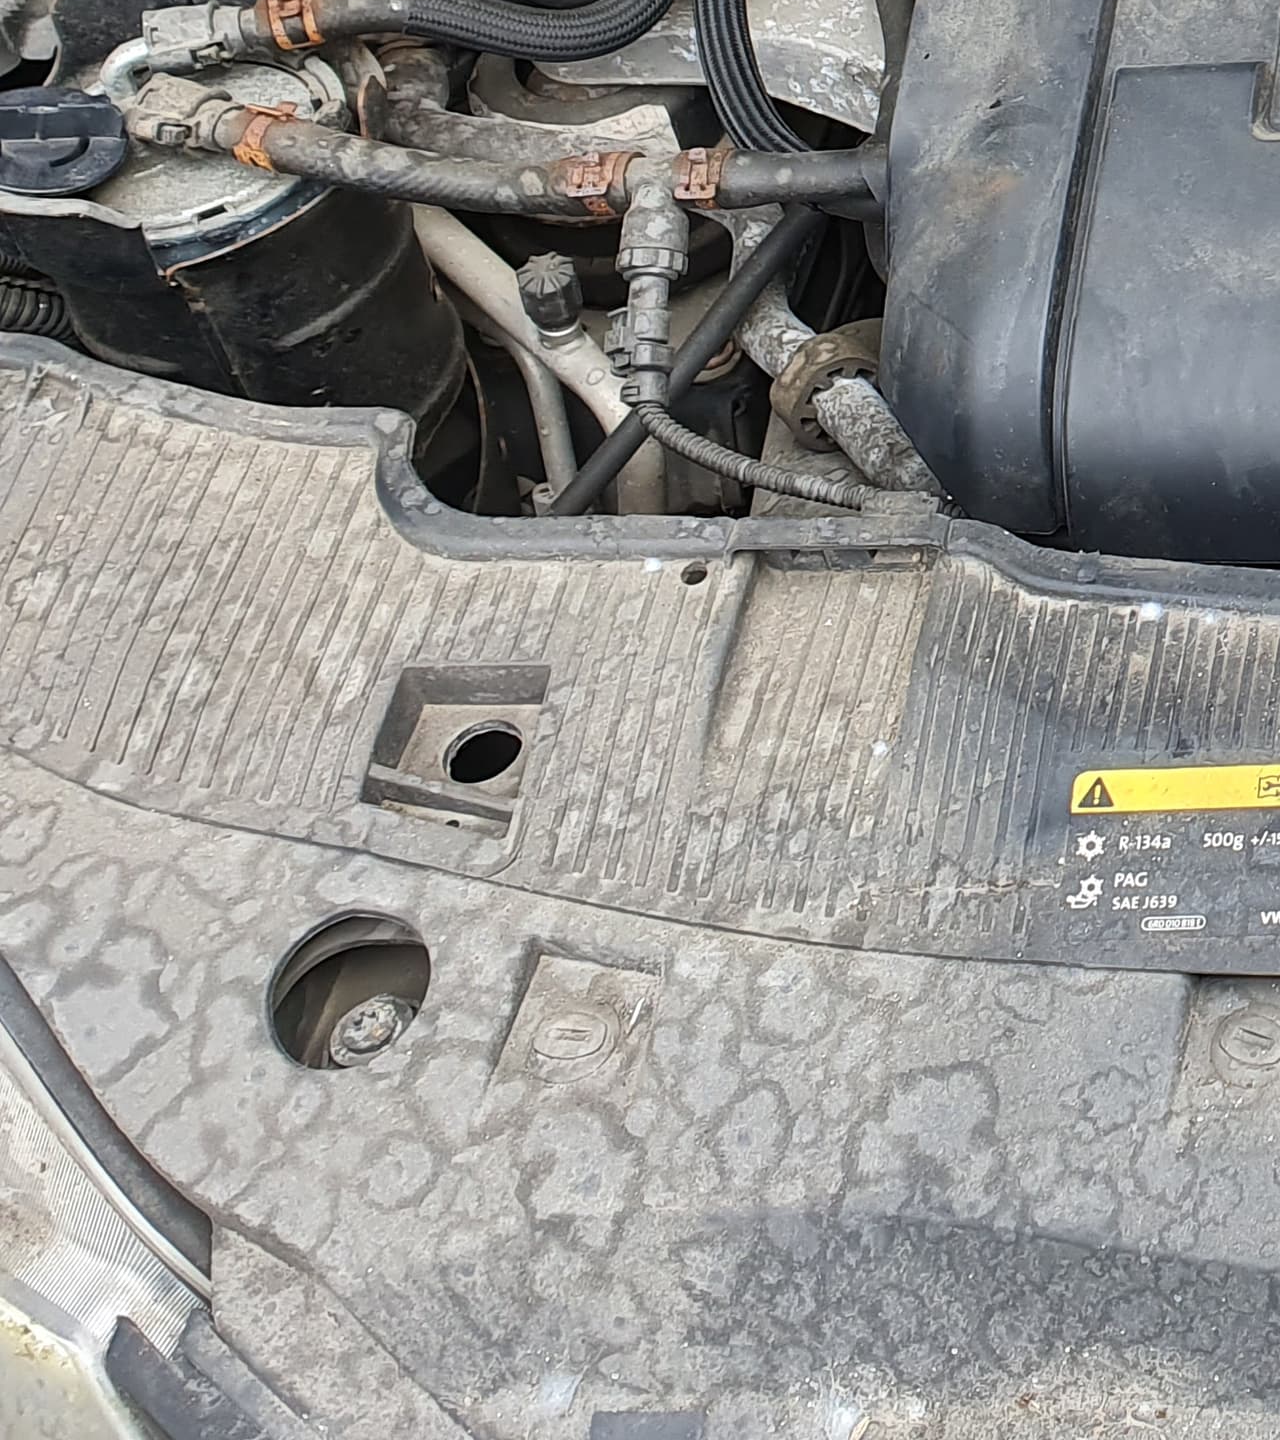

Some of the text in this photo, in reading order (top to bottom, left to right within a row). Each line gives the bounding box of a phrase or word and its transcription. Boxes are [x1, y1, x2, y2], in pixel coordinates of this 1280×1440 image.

[1119, 834, 1172, 850] R-134a
[1203, 832, 1244, 851] 500g
[1113, 872, 1148, 888] PAG
[1112, 895, 1178, 910] SAE J639
